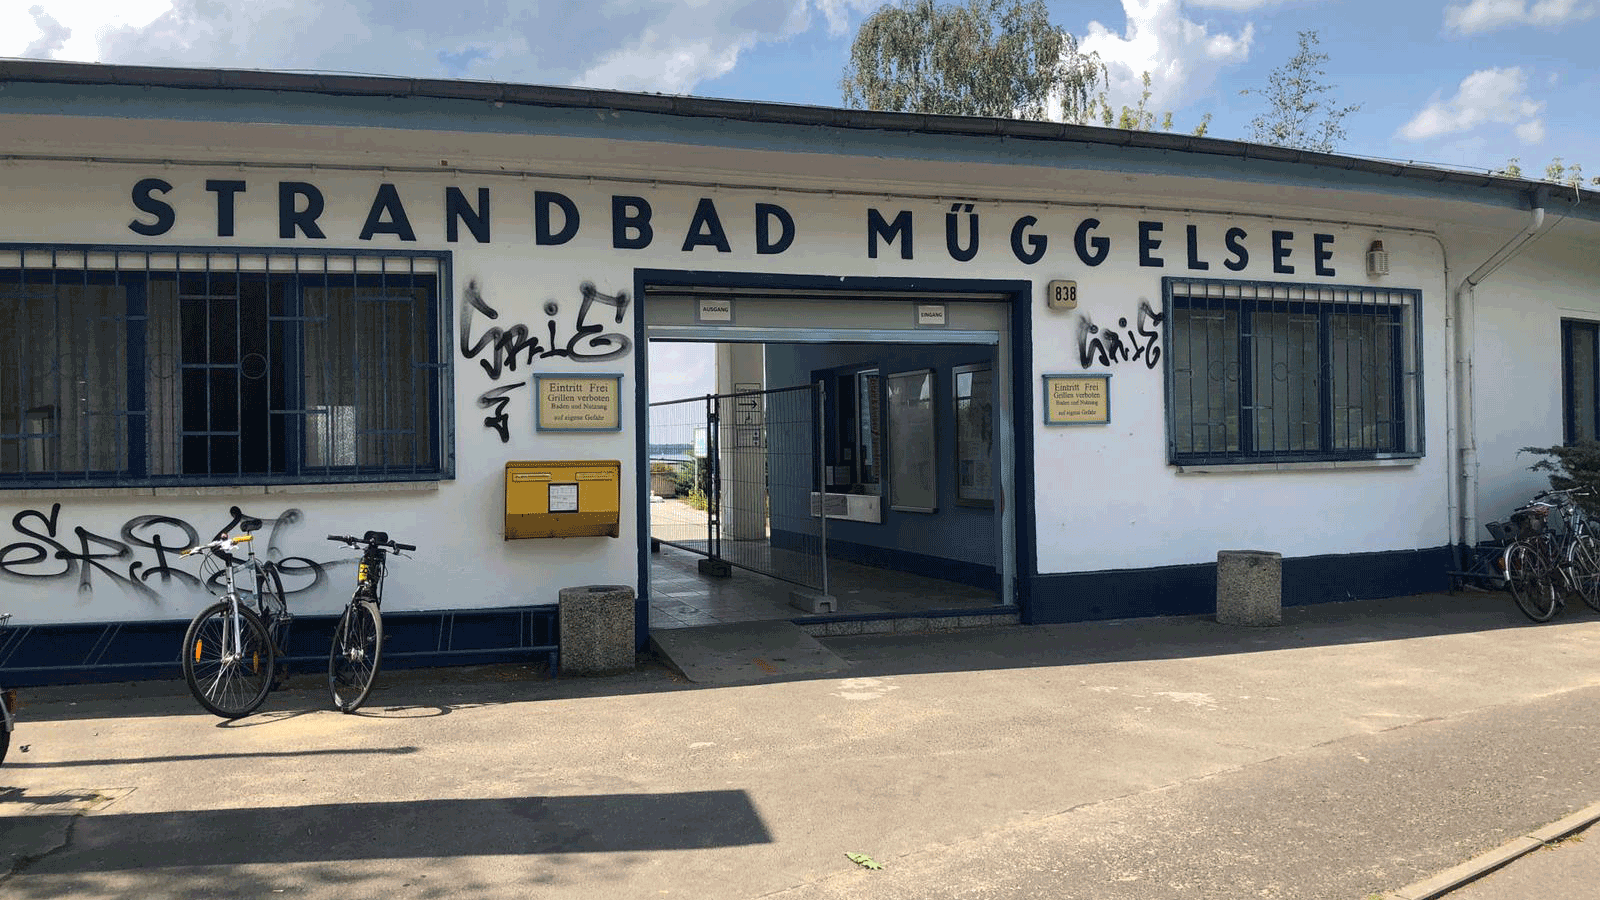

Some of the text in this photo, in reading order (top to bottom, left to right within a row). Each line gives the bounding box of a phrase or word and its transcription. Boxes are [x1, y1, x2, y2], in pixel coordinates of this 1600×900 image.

[128, 178, 1335, 277] STRANDBAD MÜGGELSEE
[1055, 286, 1076, 301] 838
[549, 383, 608, 392] Eintritt Frei
[1054, 382, 1099, 391] Eintritt Frei
[547, 394, 610, 402] Grillen verboten
